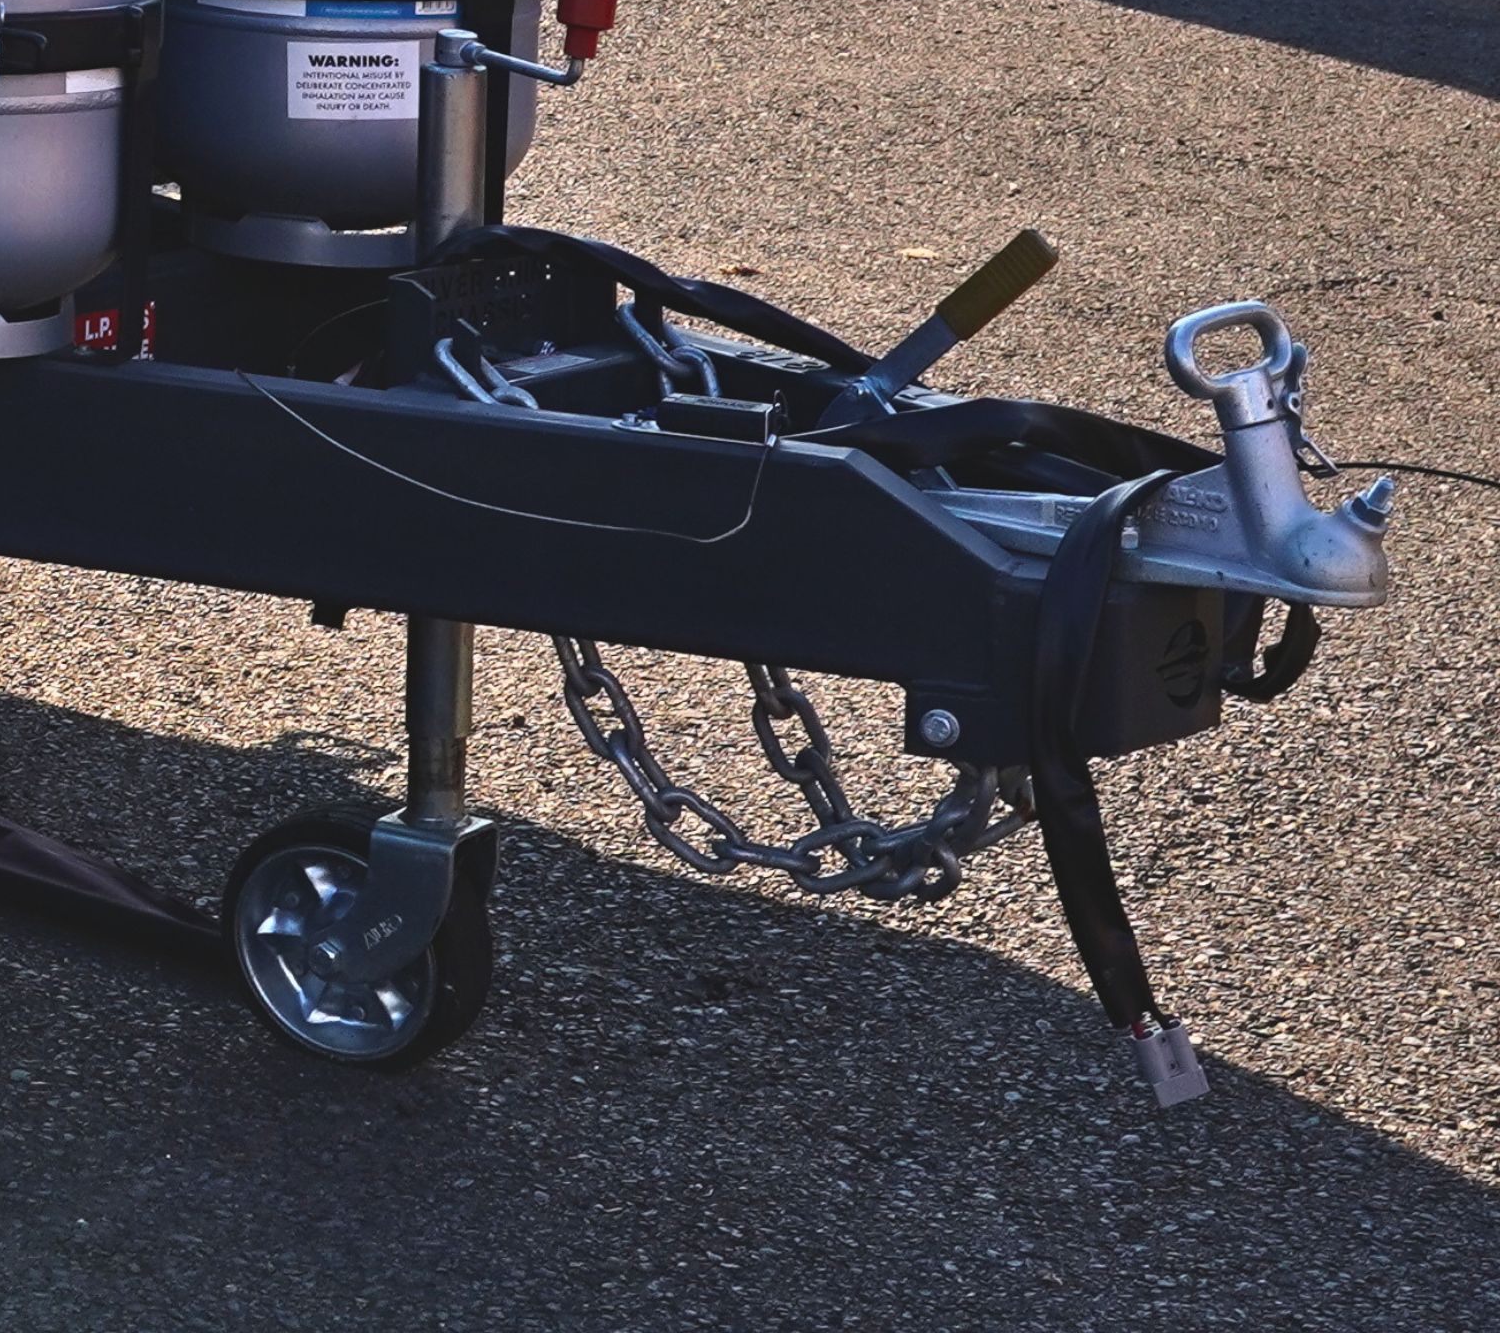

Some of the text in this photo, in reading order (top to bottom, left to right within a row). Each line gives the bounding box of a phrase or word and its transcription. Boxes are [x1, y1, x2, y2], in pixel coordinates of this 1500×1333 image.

[308, 55, 399, 67] WARNING:
[296, 82, 411, 90] DELIBERATE CONCENTRATED
[85, 316, 112, 341] L.P.
